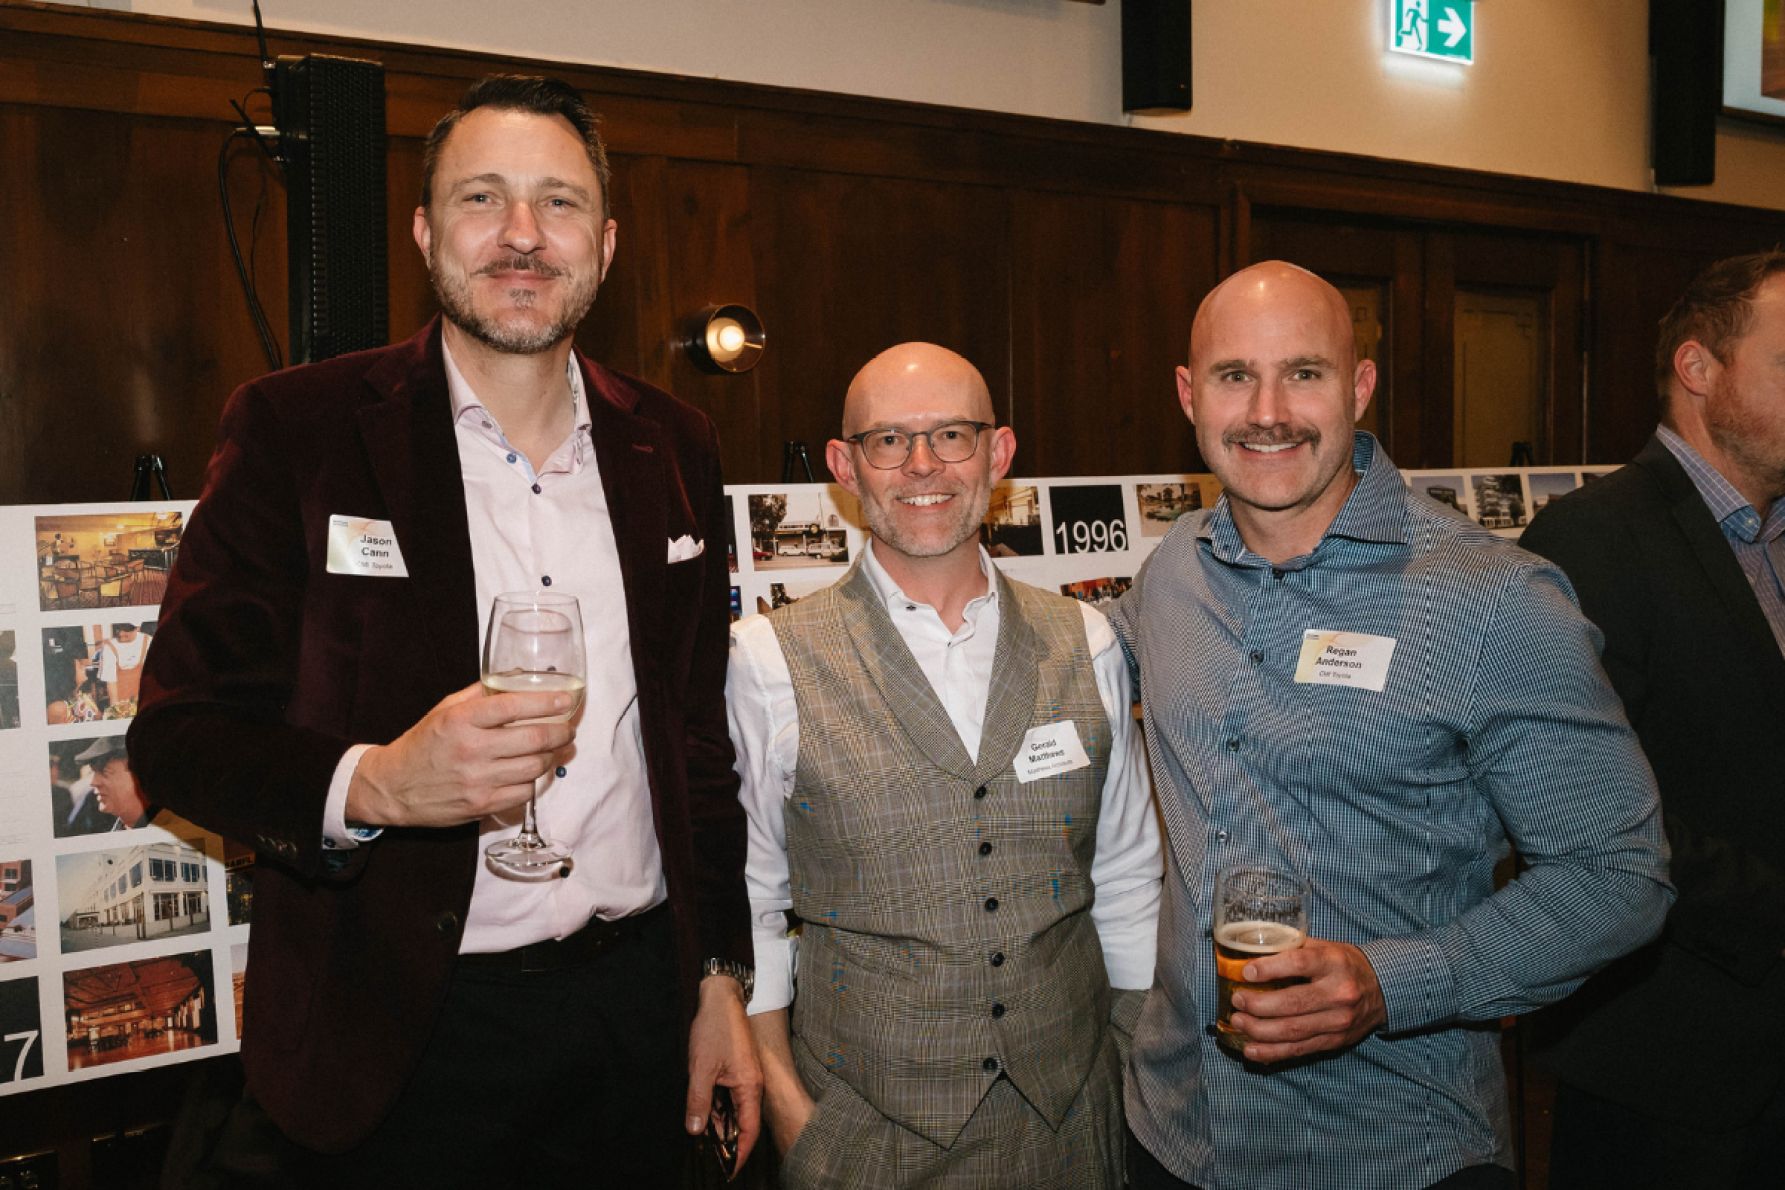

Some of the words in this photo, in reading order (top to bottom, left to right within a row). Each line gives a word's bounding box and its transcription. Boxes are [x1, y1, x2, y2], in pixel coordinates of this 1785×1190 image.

[360, 534, 392, 546] Jason
[1056, 519, 1127, 554] 1996
[361, 547, 389, 558] Cann
[1326, 645, 1358, 657] Regan
[1315, 657, 1362, 669] Anderson
[1031, 739, 1057, 752] Gerald
[4, 1030, 38, 1081] 7
